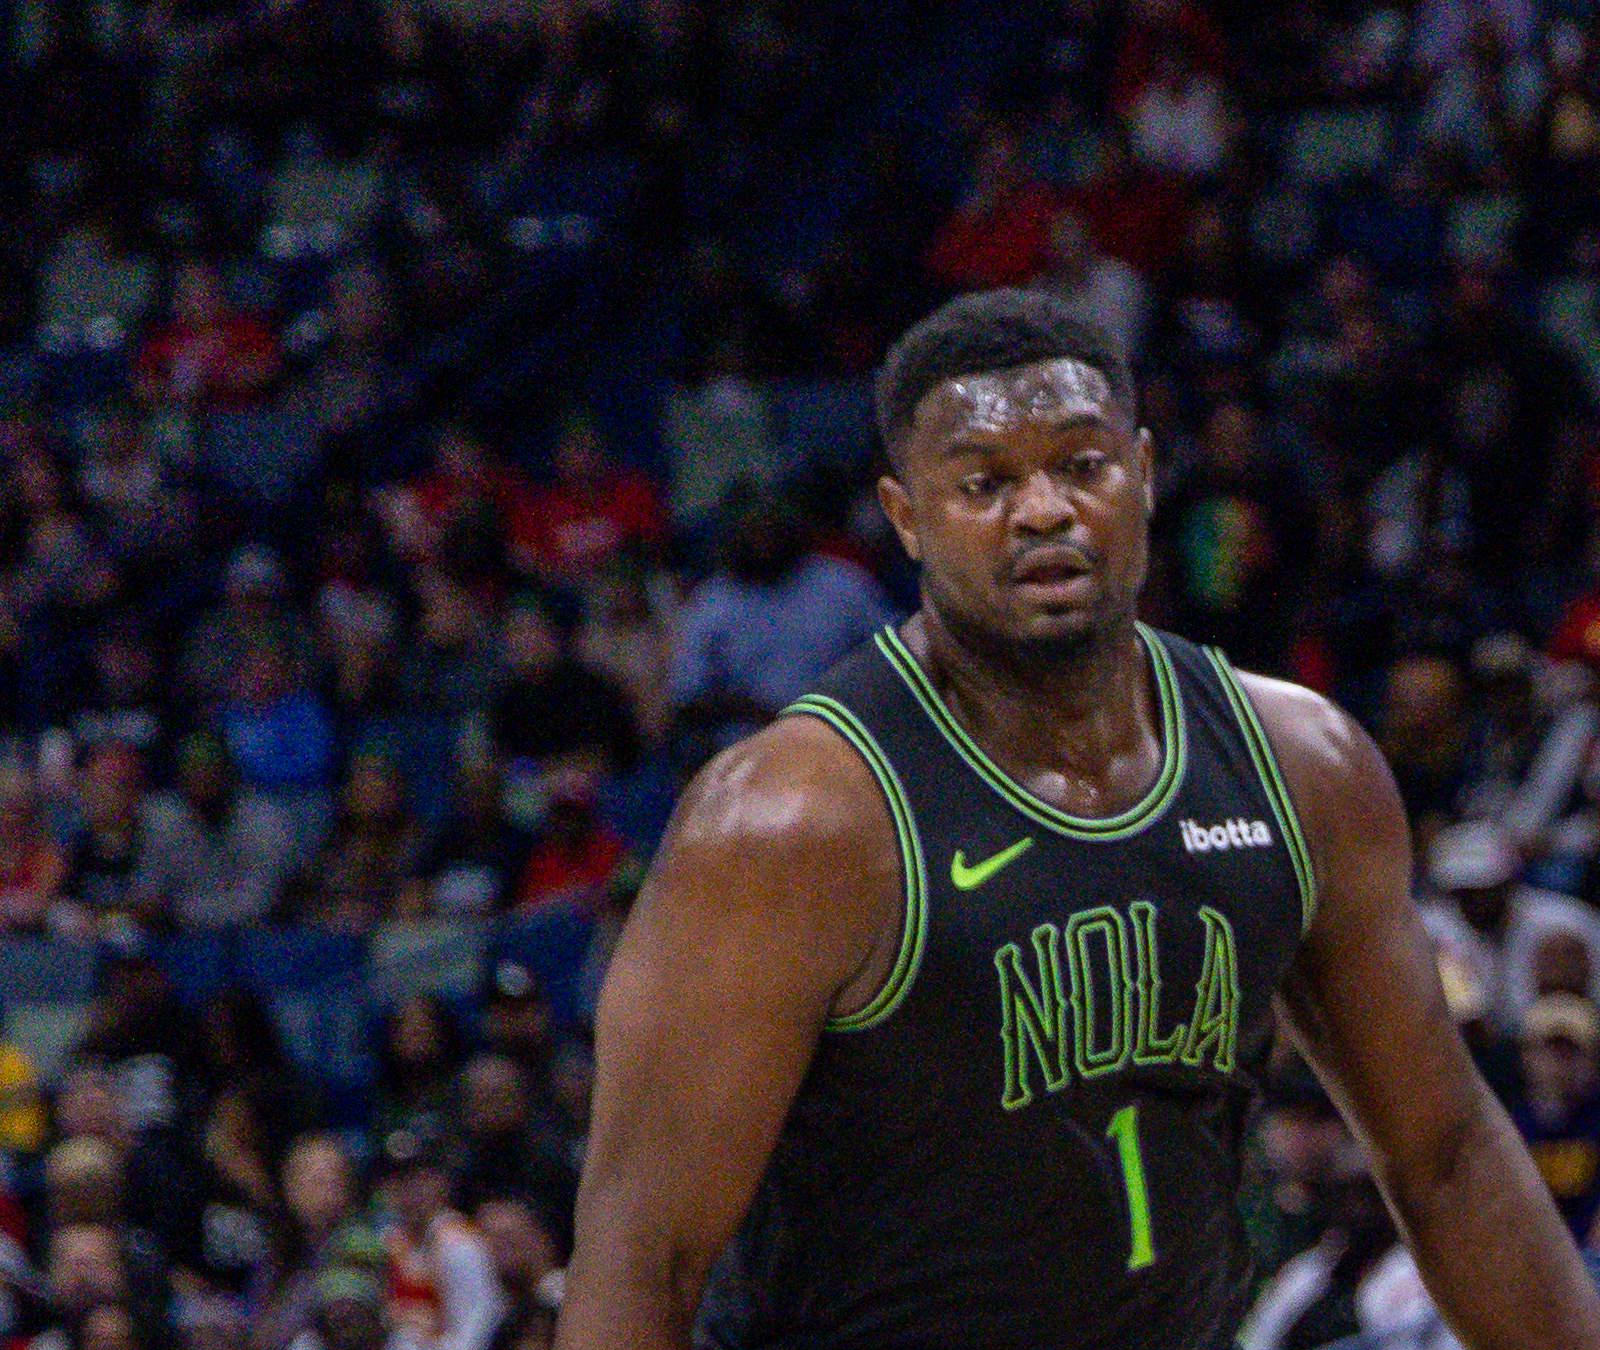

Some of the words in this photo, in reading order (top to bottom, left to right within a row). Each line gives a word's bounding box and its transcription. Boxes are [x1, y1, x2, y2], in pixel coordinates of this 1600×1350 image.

[1179, 817, 1273, 853] ibotta
[994, 901, 1241, 1110] NOLA
[1105, 1106, 1155, 1272] 1
